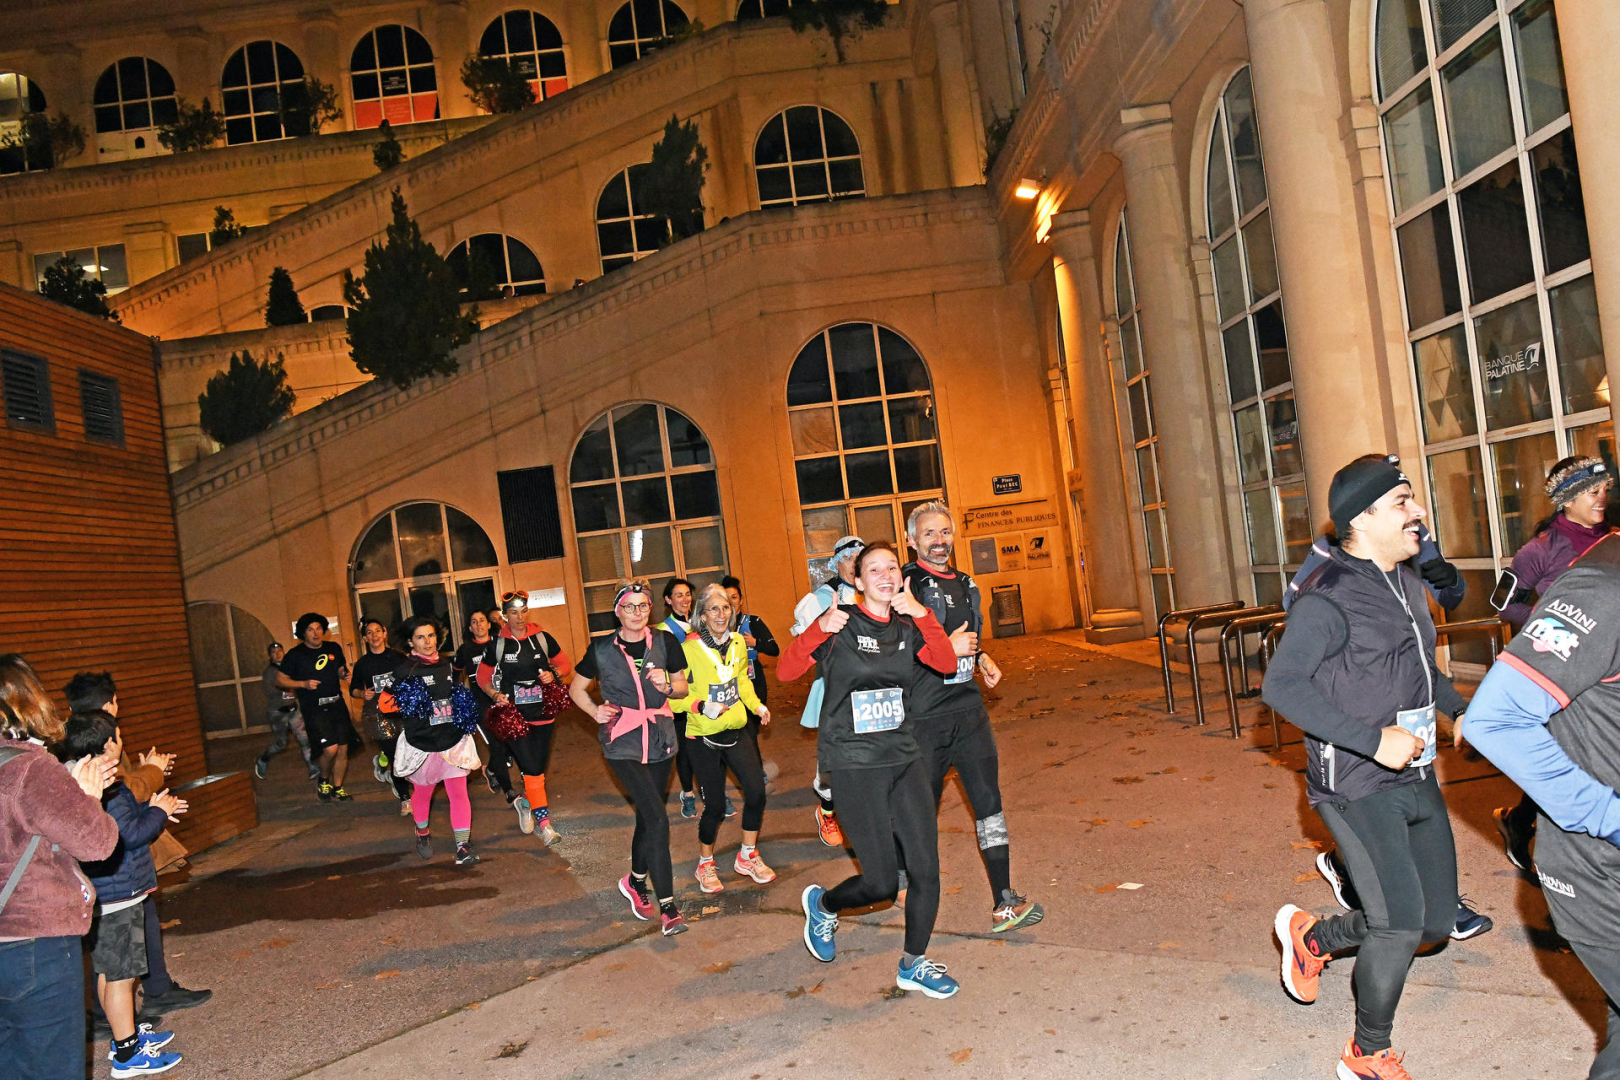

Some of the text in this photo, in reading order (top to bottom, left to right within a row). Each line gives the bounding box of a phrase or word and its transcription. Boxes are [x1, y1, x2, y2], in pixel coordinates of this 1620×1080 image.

[1485, 350, 1524, 370] BANQUE
[1486, 361, 1525, 380] PALATINE
[976, 511, 999, 519] Centre
[977, 513, 1056, 529] FINANCES PUBLIQUES
[1001, 545, 1020, 554] SMA
[716, 686, 736, 702] 829
[860, 700, 902, 720] 2005
